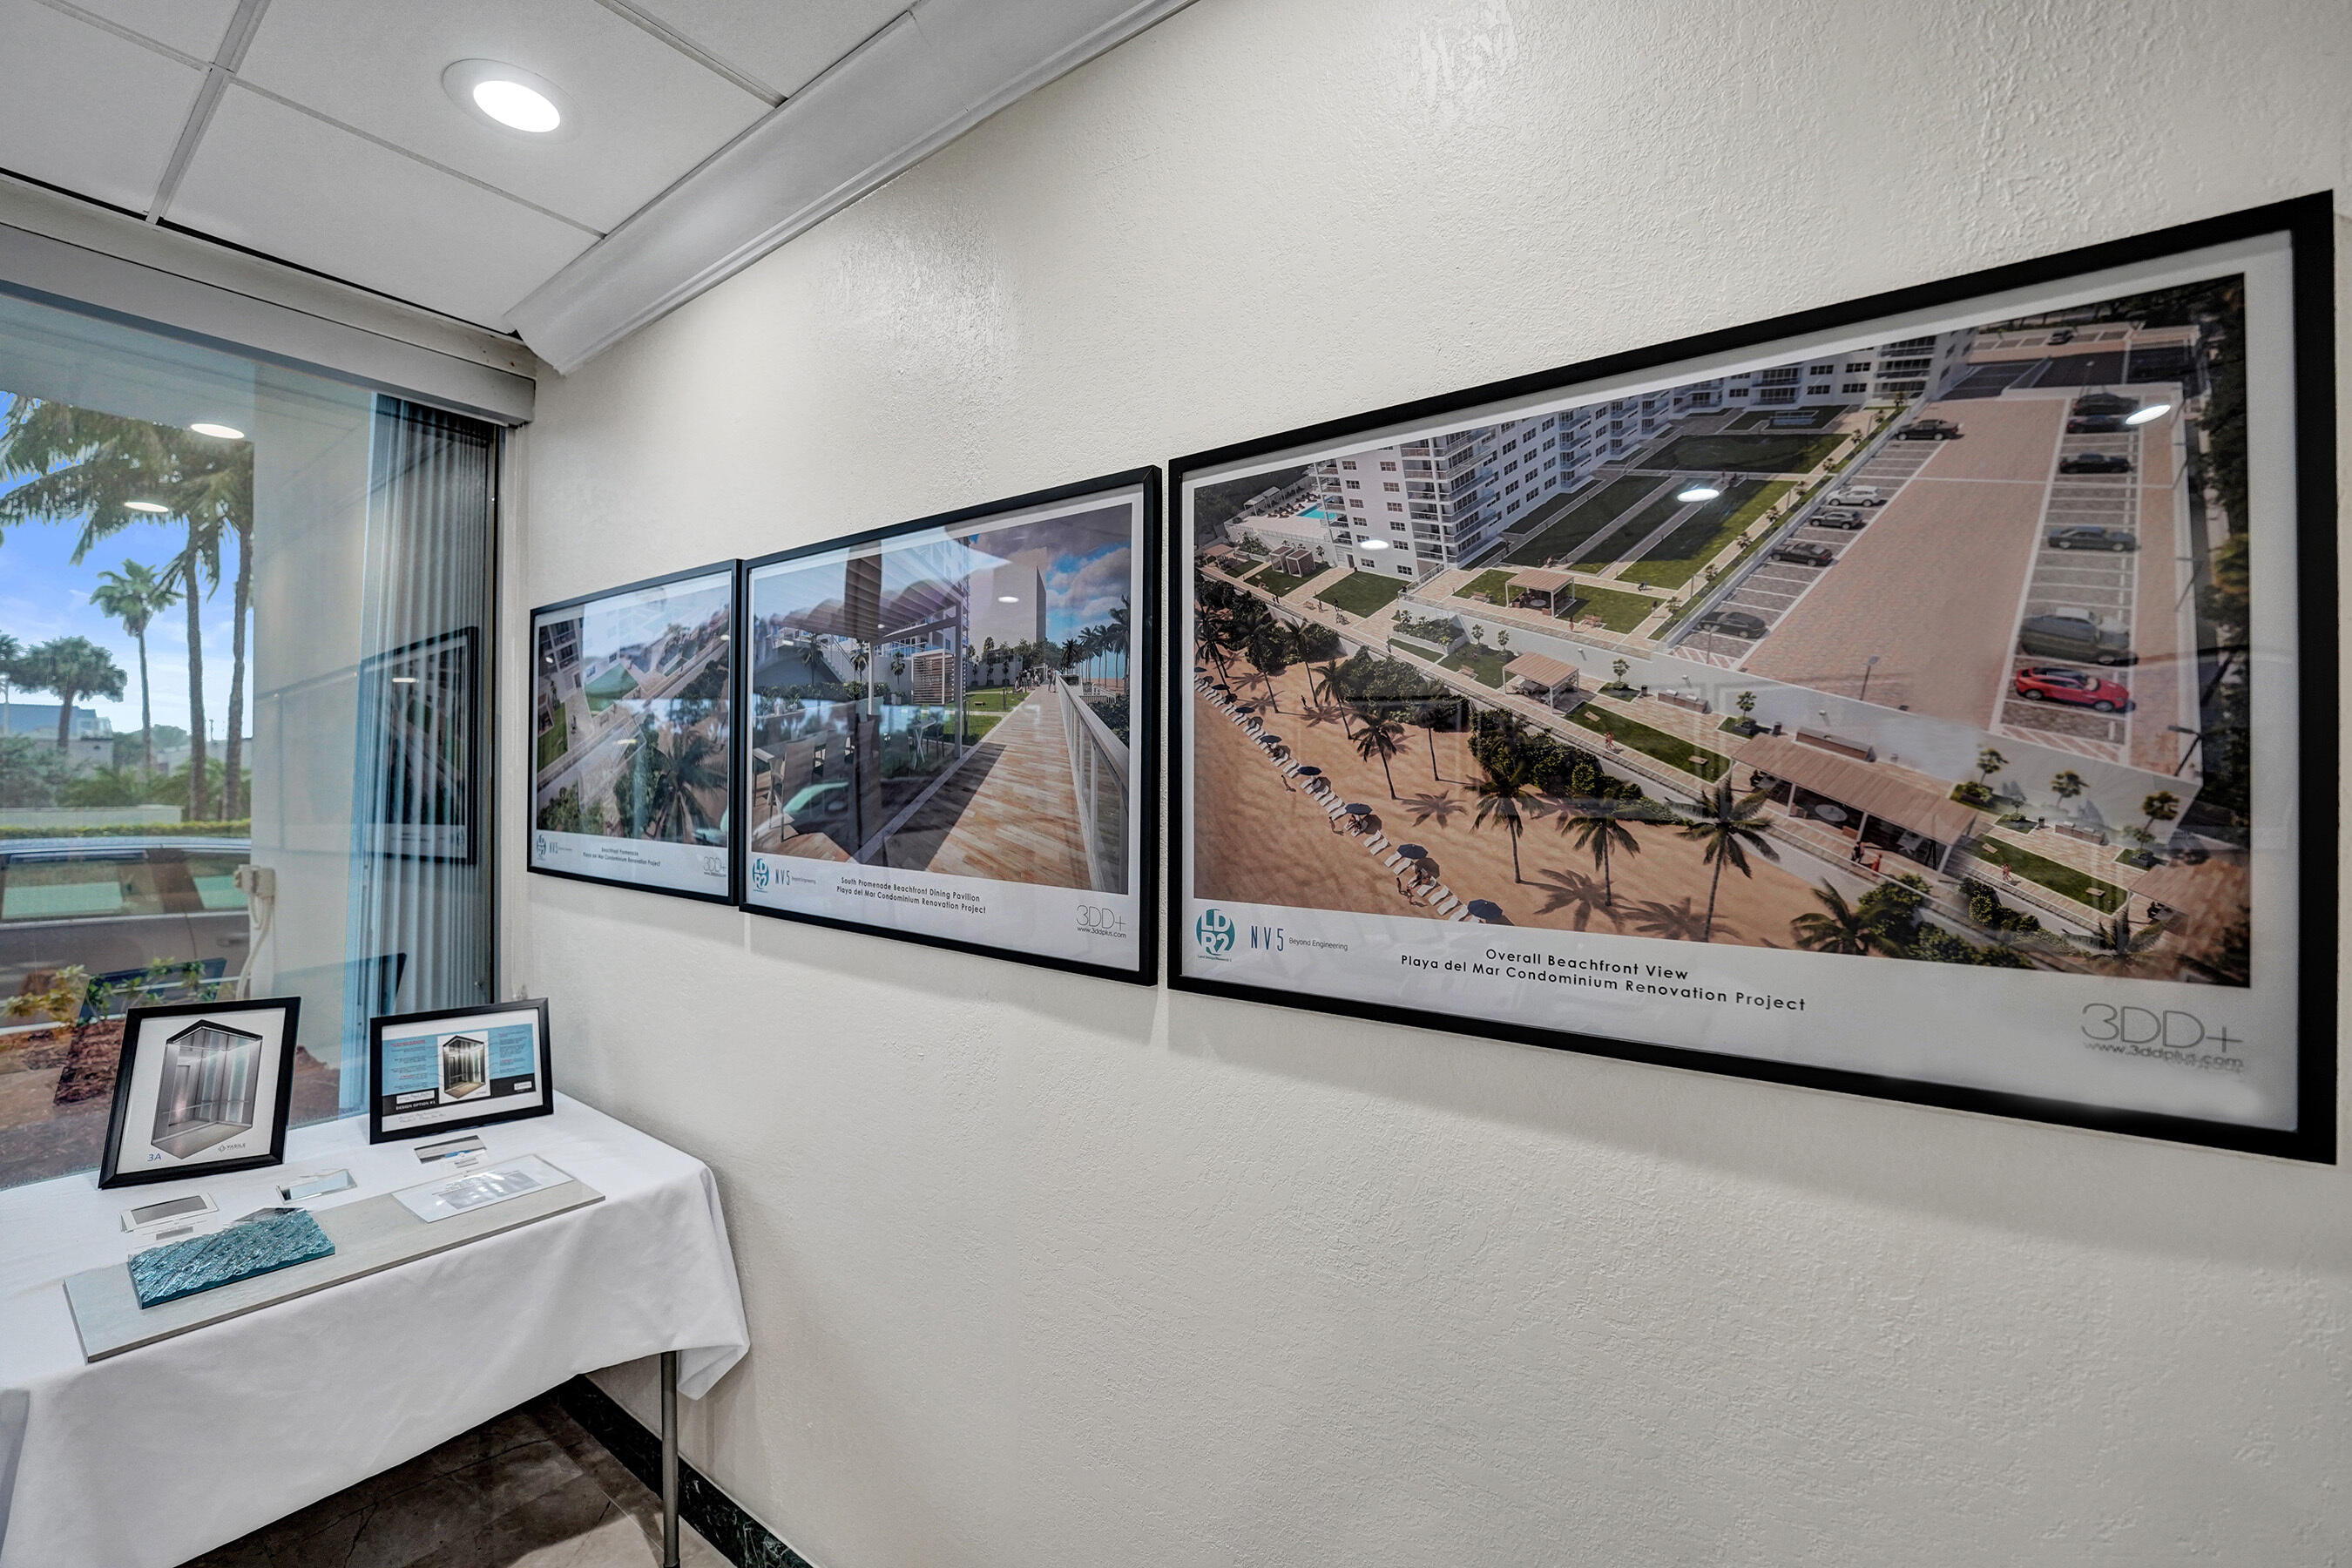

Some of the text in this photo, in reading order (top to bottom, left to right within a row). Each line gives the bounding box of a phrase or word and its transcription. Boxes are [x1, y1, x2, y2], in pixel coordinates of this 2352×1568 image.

[836, 885, 987, 915] Playa del Mar Condominium Renovation Project
[841, 876, 980, 902] South Promenade Beachfront Dining Pavilion
[1076, 904, 1127, 931] 3DD+
[1077, 926, 1127, 939] www.3ddplus.com
[1288, 936, 1311, 948] Beyond
[1312, 939, 1348, 952] Engineering
[1485, 948, 1689, 980] Overall Beachfront View
[1401, 954, 1806, 1010] Playa del Mar Condominium Renovation Project
[2081, 1003, 2245, 1053] 3DD+
[146, 1152, 162, 1162] 3A
